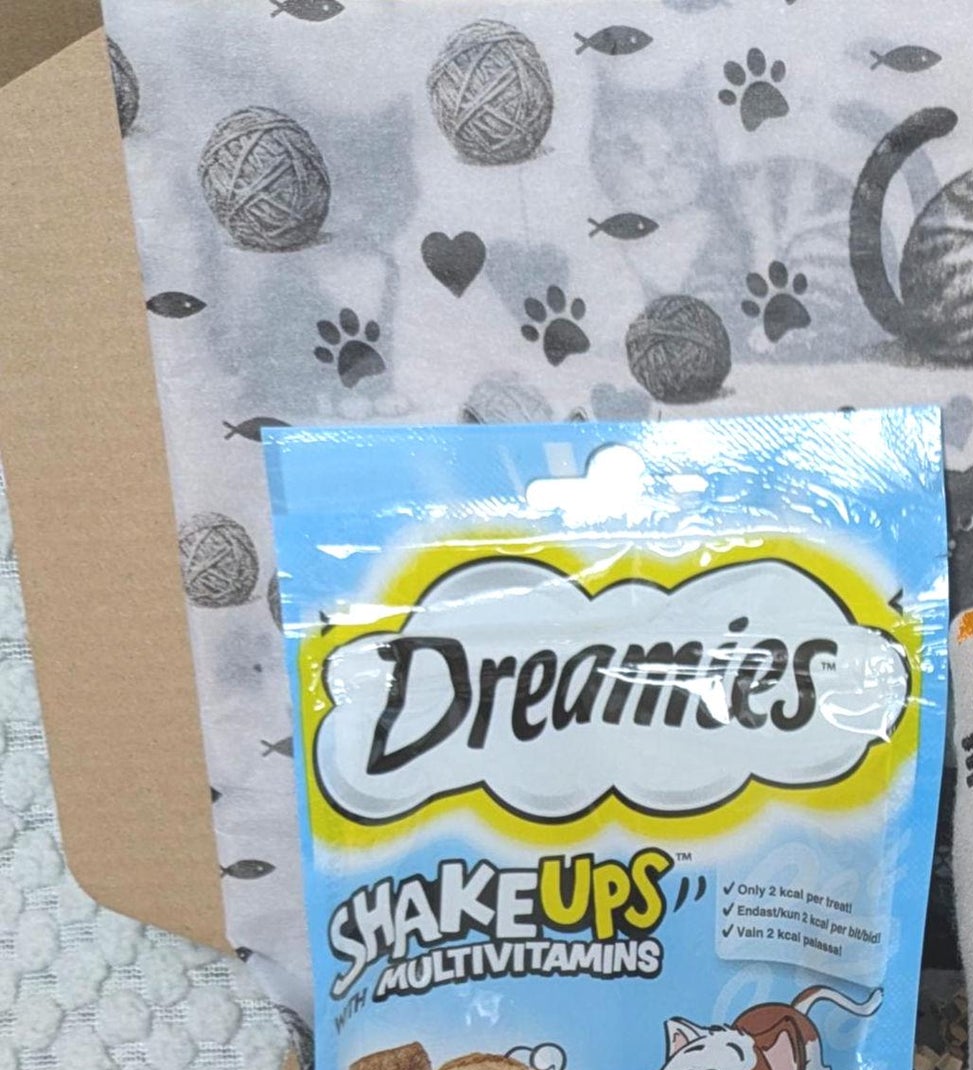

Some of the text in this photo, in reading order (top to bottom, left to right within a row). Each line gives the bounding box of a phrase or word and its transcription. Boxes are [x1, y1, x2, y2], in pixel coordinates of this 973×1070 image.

[737, 884, 853, 914] Only 2 kcal per treat!
[737, 905, 801, 920] Endast/kun
[802, 914, 809, 923] 2
[810, 914, 830, 930] kcal
[832, 922, 847, 935] per
[737, 926, 842, 957] Vain 2 kcal palassa!
[373, 936, 664, 1003] MULTIVITAMINS
